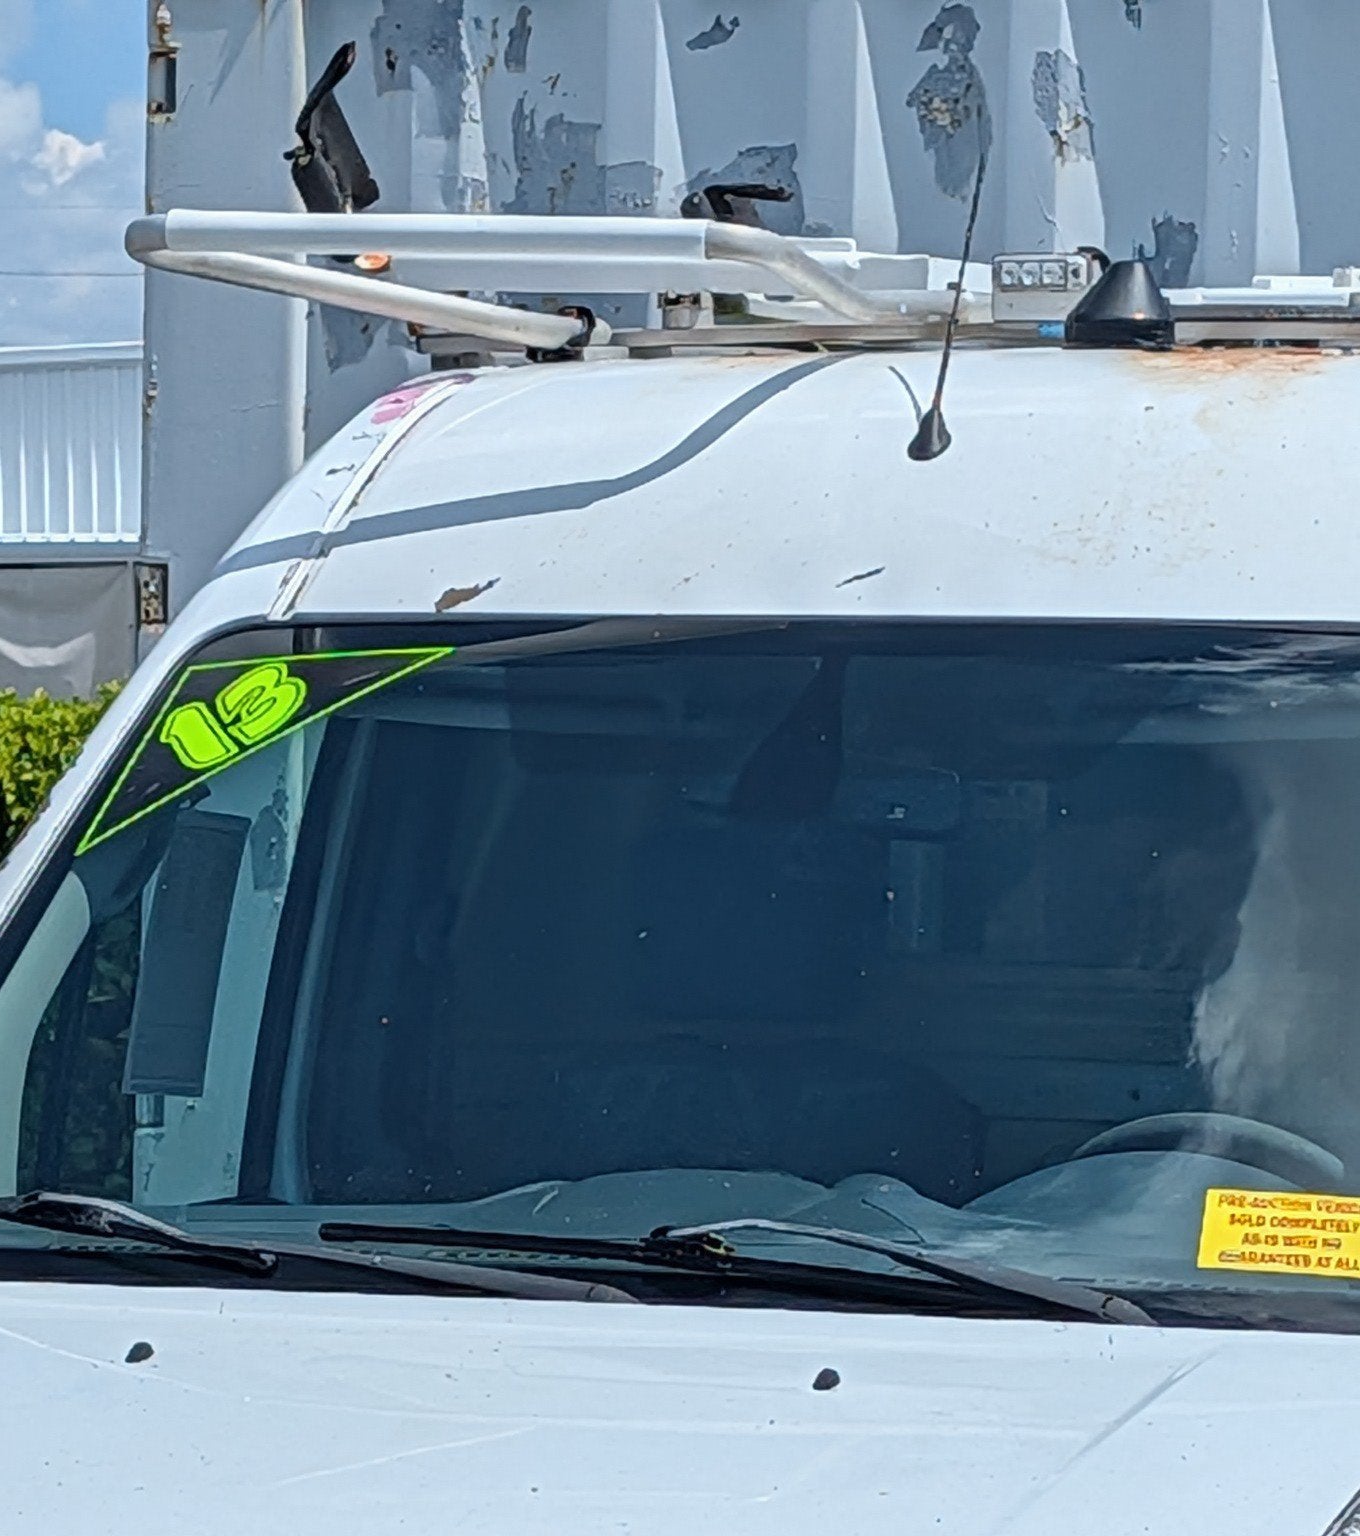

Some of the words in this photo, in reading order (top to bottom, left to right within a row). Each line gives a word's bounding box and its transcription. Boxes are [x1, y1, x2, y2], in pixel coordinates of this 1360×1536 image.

[159, 662, 307, 769] 13
[1229, 1213, 1266, 1227] SOLD
[1269, 1216, 1360, 1233] COMPLETELY
[1241, 1232, 1262, 1246] AS
[1264, 1234, 1278, 1246] IS
[1218, 1250, 1312, 1268] ARANTEES
[1314, 1256, 1333, 1268] AT
[1334, 1257, 1360, 1271] ALL
